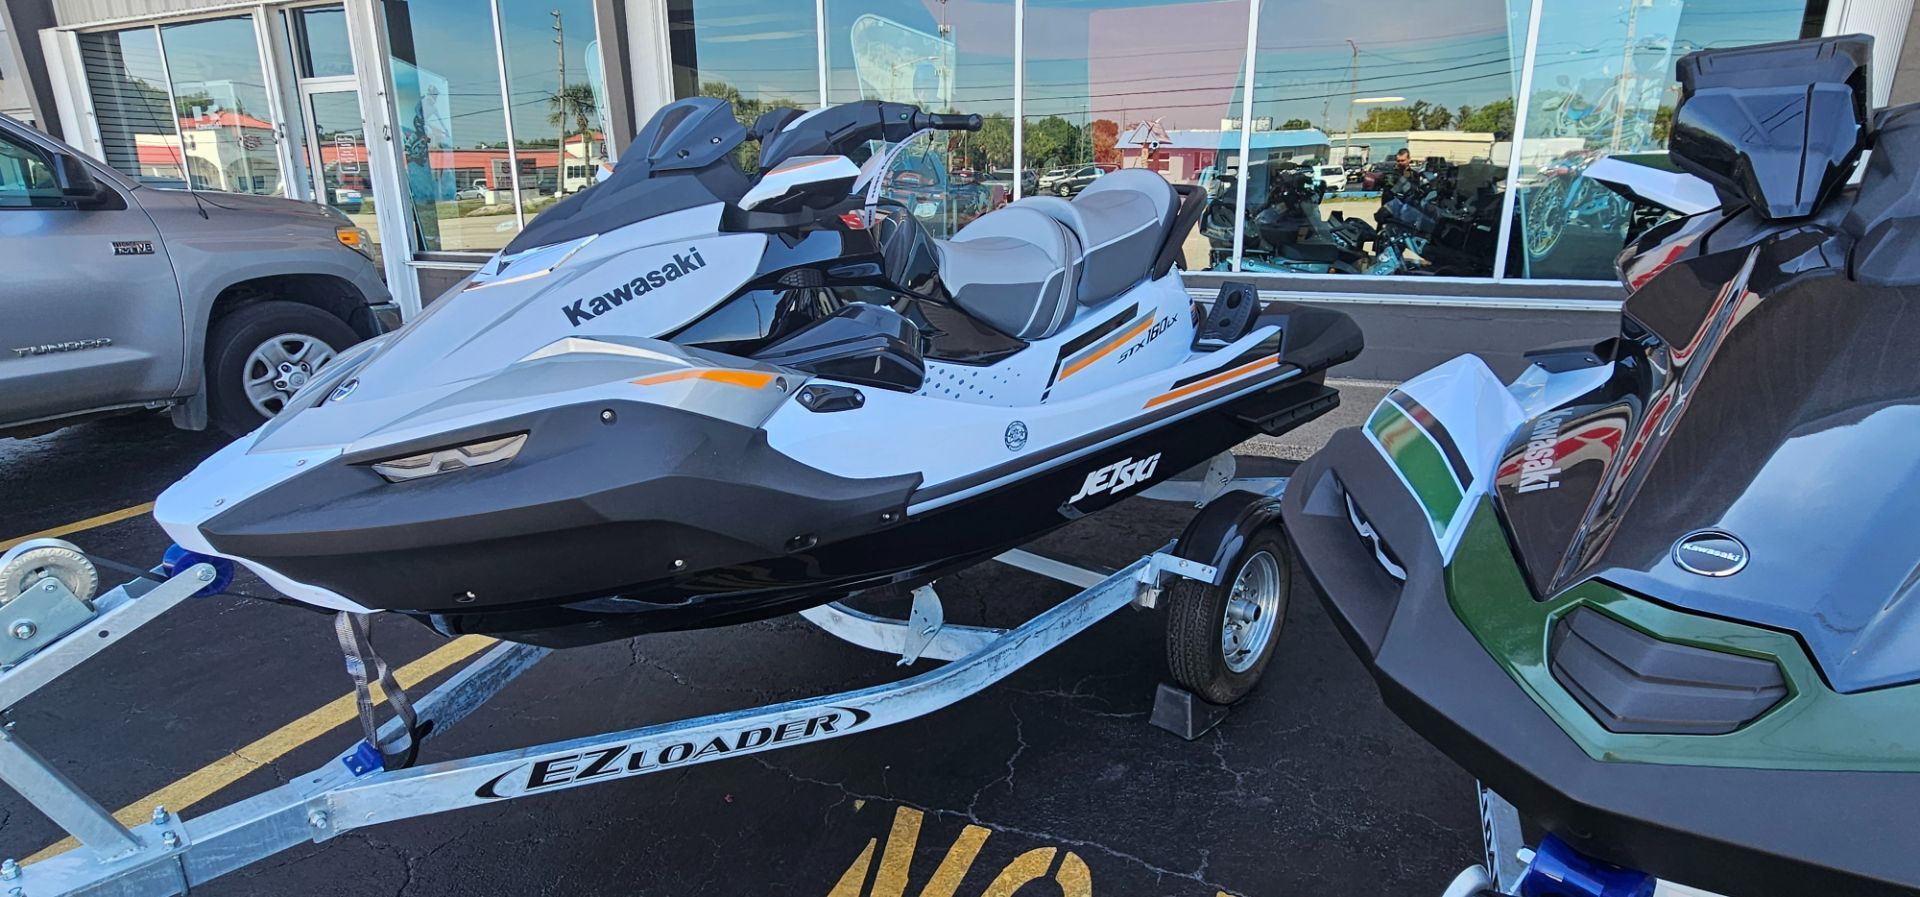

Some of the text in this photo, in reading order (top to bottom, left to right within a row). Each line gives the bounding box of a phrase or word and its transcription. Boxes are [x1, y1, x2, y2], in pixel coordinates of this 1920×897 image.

[561, 246, 707, 327] Kawasaki
[1518, 406, 1575, 494] Kawasaki
[1682, 542, 1741, 563] Kawasaki
